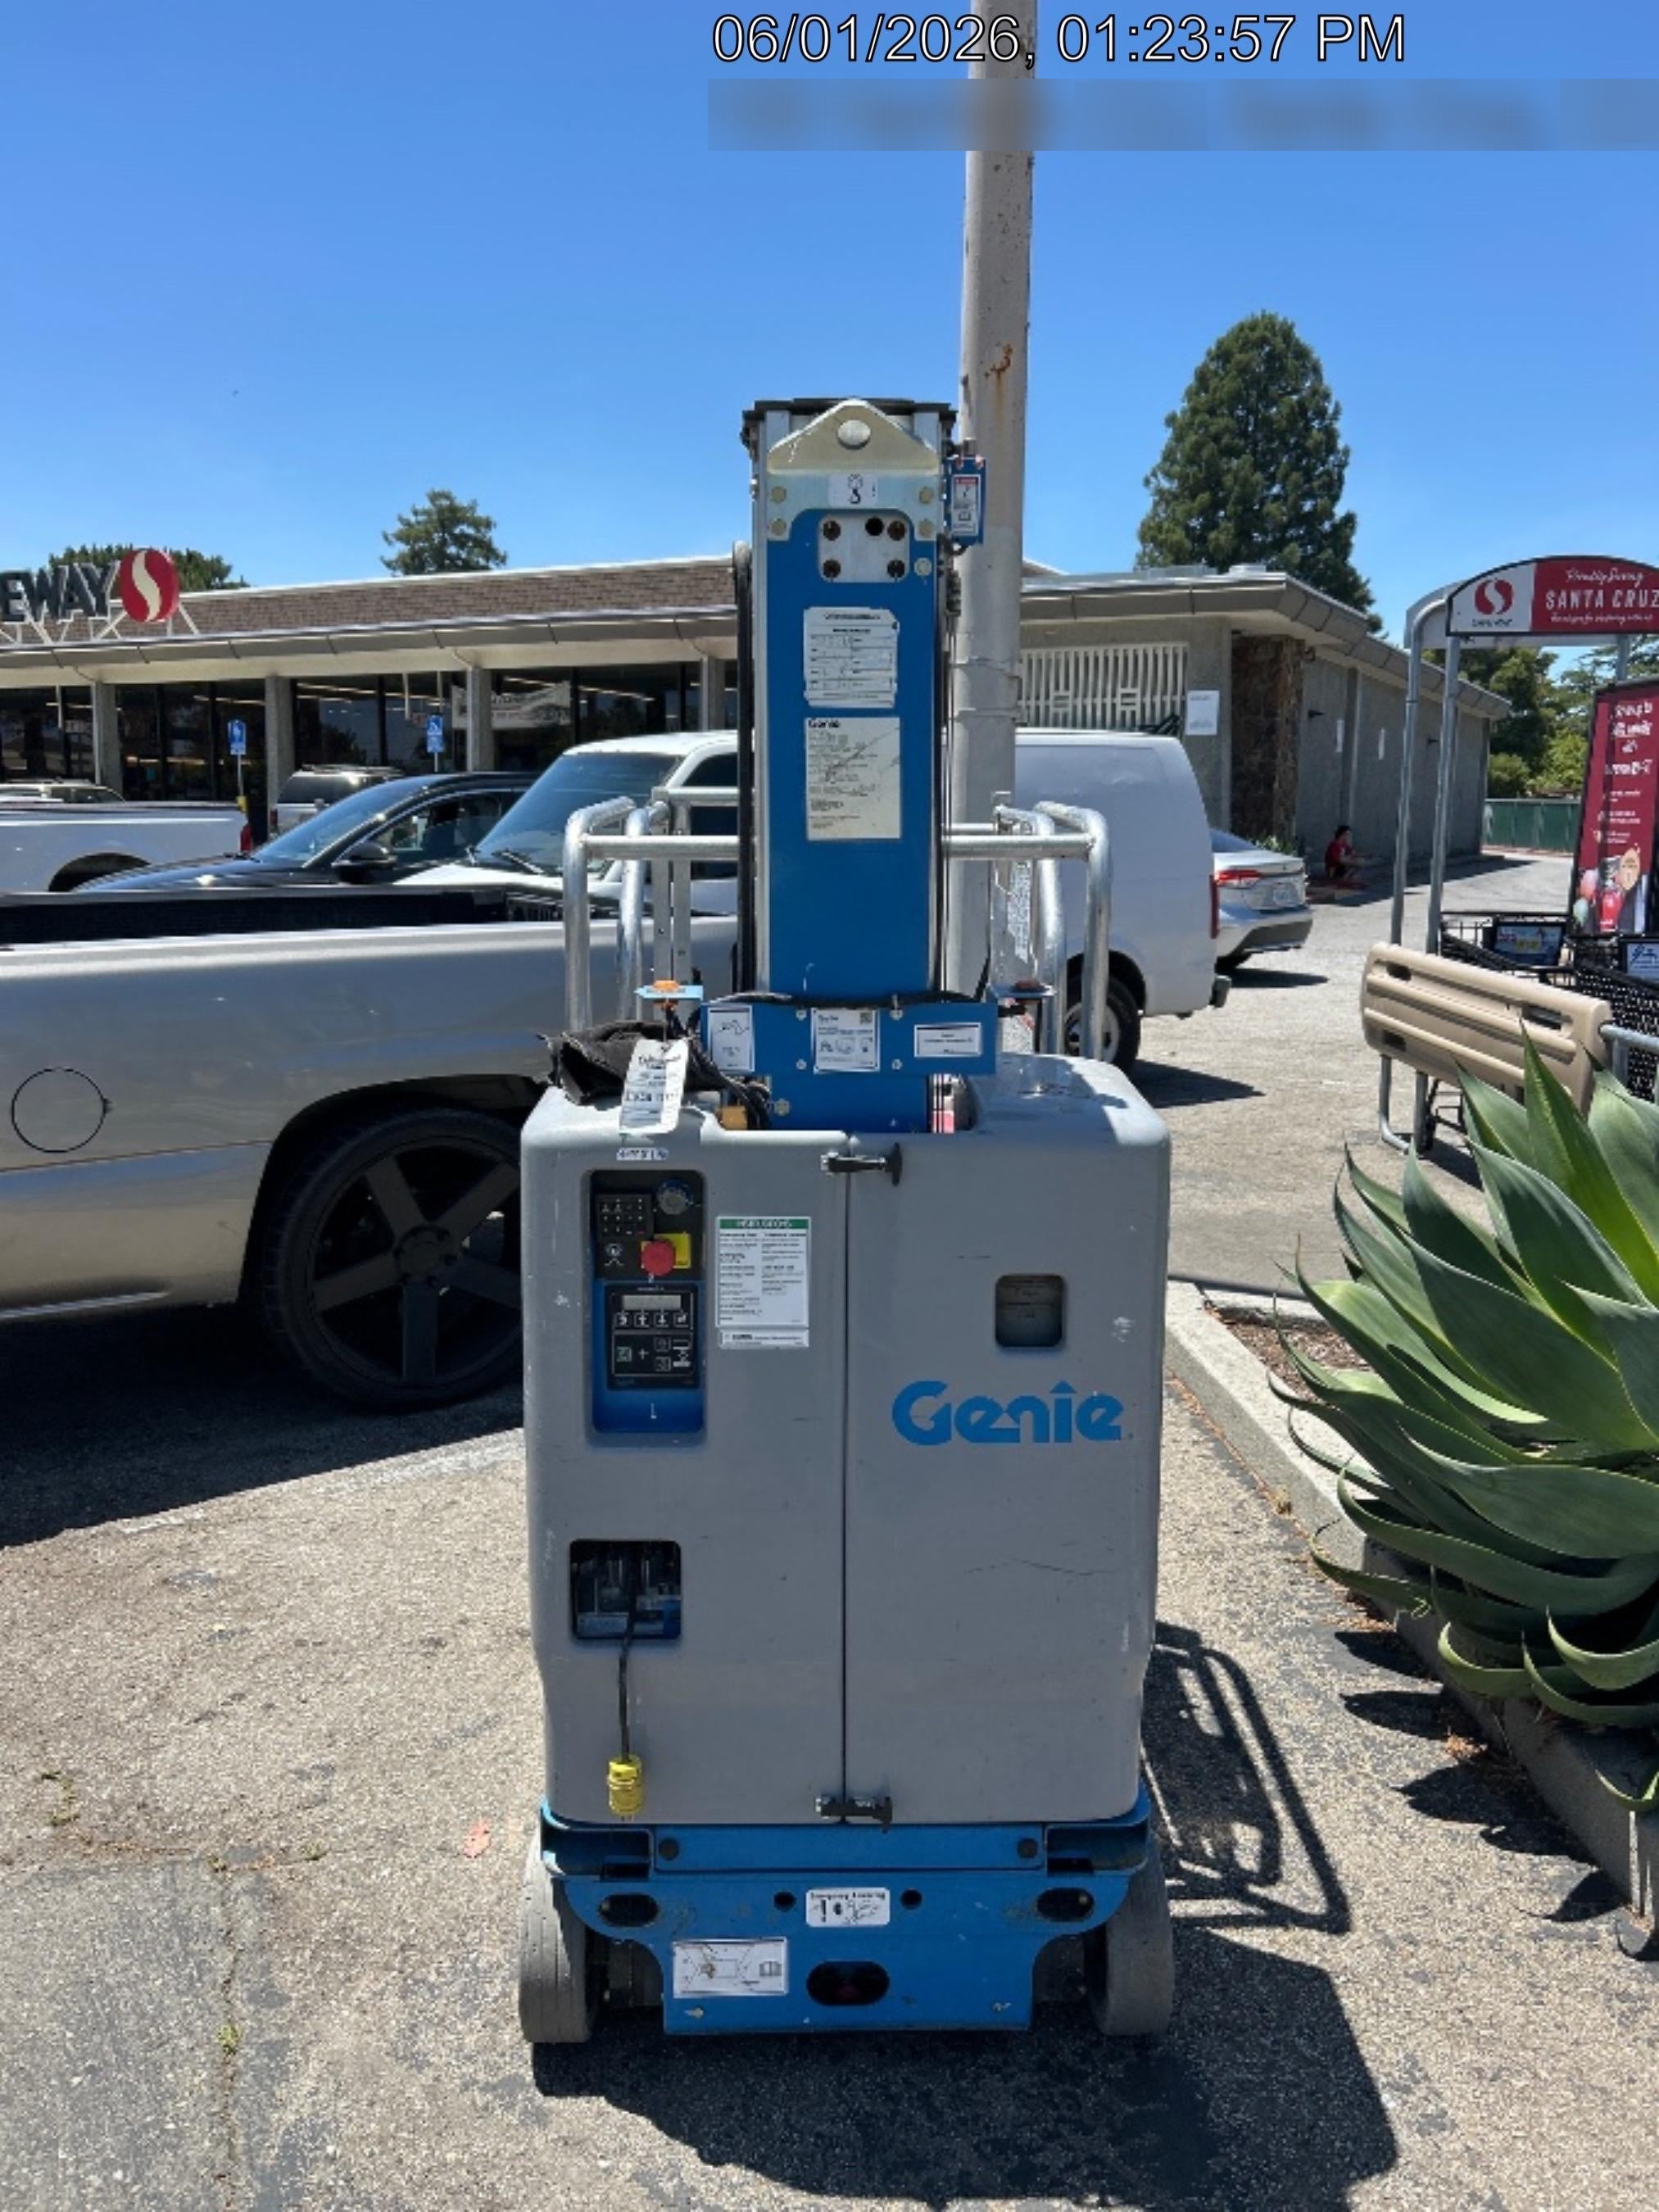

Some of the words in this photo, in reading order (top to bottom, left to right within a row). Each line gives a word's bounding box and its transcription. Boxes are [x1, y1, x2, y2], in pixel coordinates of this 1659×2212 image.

[1545, 589, 1604, 610] SANTA
[1612, 589, 1659, 609] CRUZ
[891, 1380, 1123, 1446] Genie
